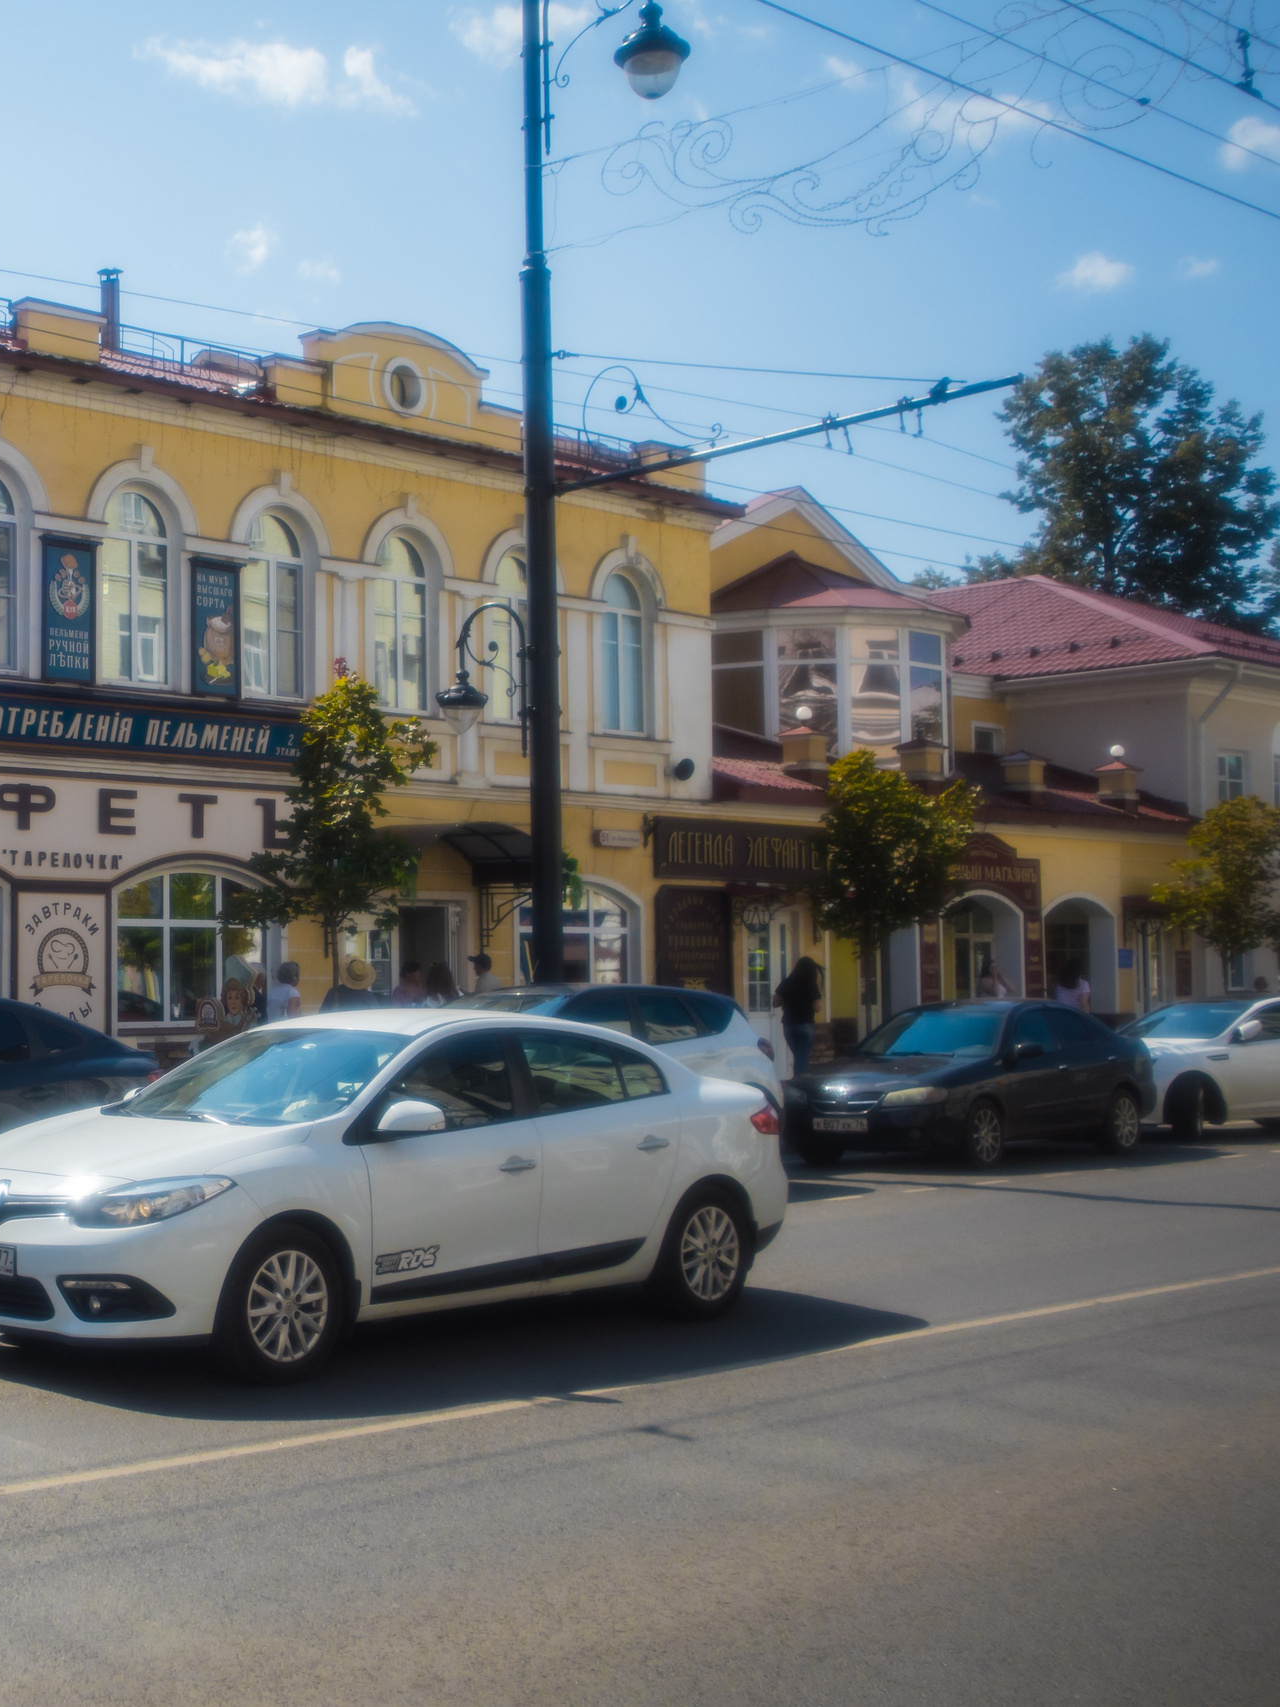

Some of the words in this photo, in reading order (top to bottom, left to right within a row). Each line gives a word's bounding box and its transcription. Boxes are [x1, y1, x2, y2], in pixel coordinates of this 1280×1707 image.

[197, 573, 206, 583] НА
[197, 583, 233, 598] ВЫСШАГО
[196, 595, 225, 610] СОРТА
[49, 627, 89, 640] ПЕЛЬМЕНИ
[49, 638, 89, 655] РУЧНОЙ
[144, 718, 271, 755] ПЕЛЬМЕНЕЙ
[287, 733, 295, 746] 2
[600, 832, 609, 842] 51
[984, 864, 1037, 883] МАГАЗИНЪ
[24, 900, 99, 936] ЗАВТРАКИ
[35, 973, 89, 986] ТАРЕЛОЧКА
[397, 1244, 440, 1270] RDS
